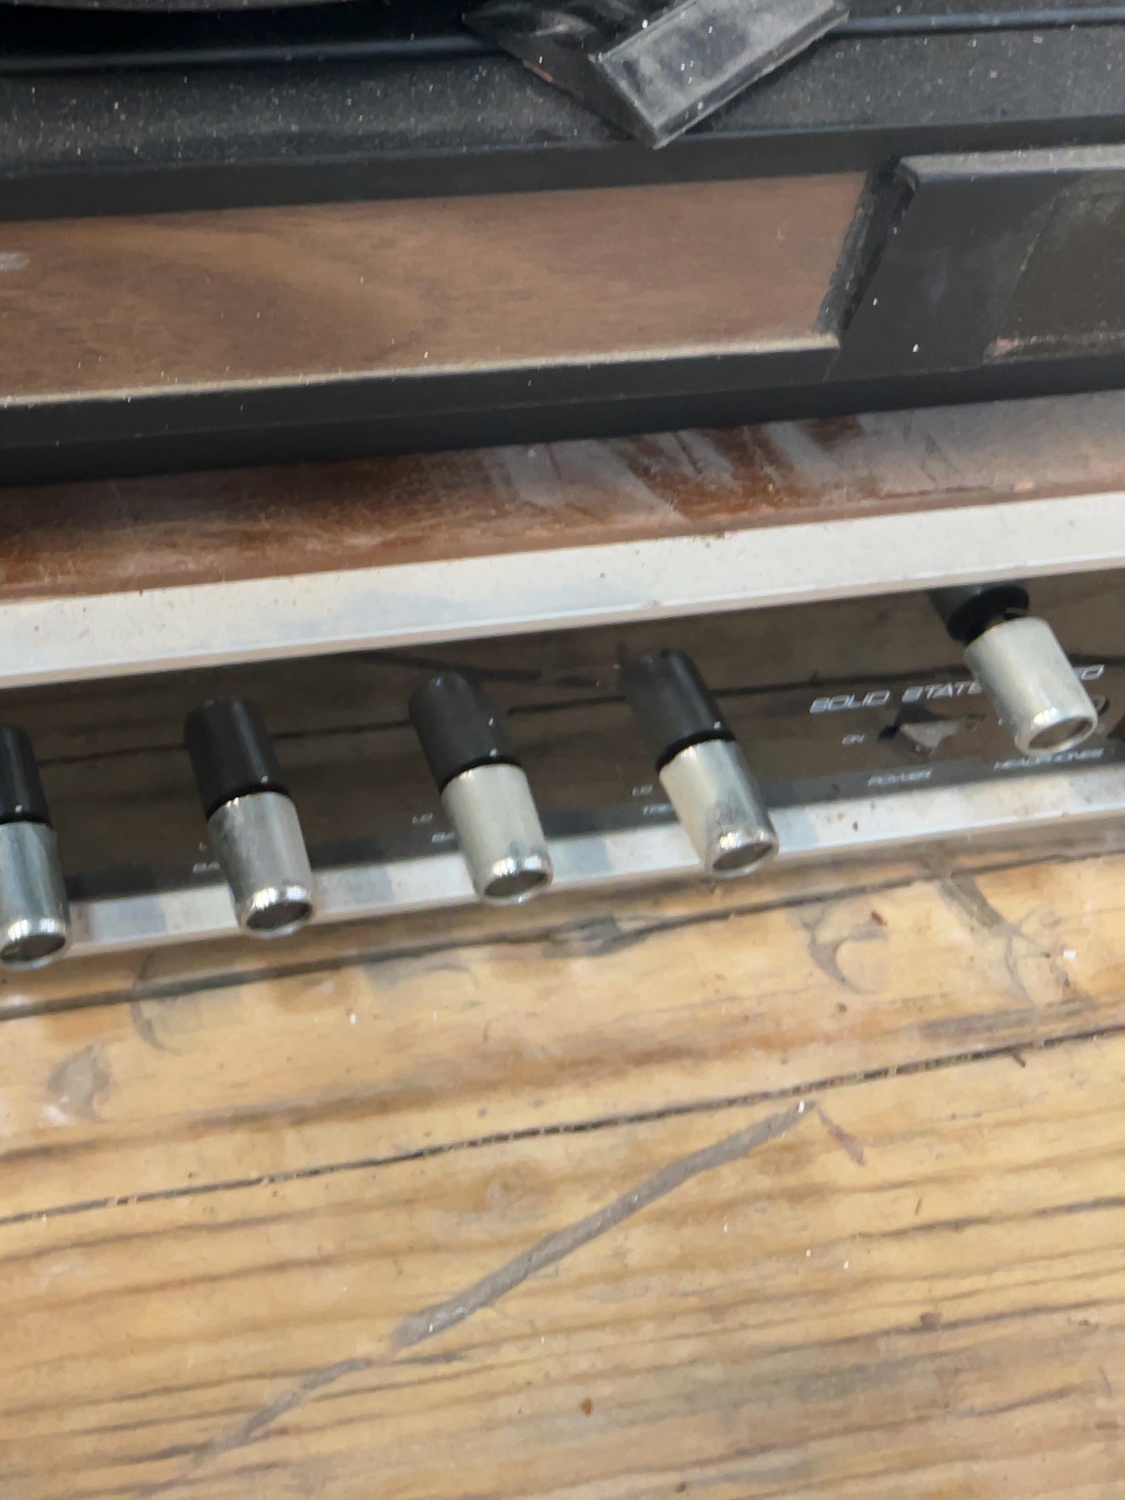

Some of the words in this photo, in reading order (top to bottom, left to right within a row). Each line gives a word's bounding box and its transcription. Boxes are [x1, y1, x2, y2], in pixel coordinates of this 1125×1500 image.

[809, 688, 891, 715] SOLID
[901, 681, 983, 704] STATE
[841, 733, 866, 746] ON
[867, 768, 933, 787] POWER
